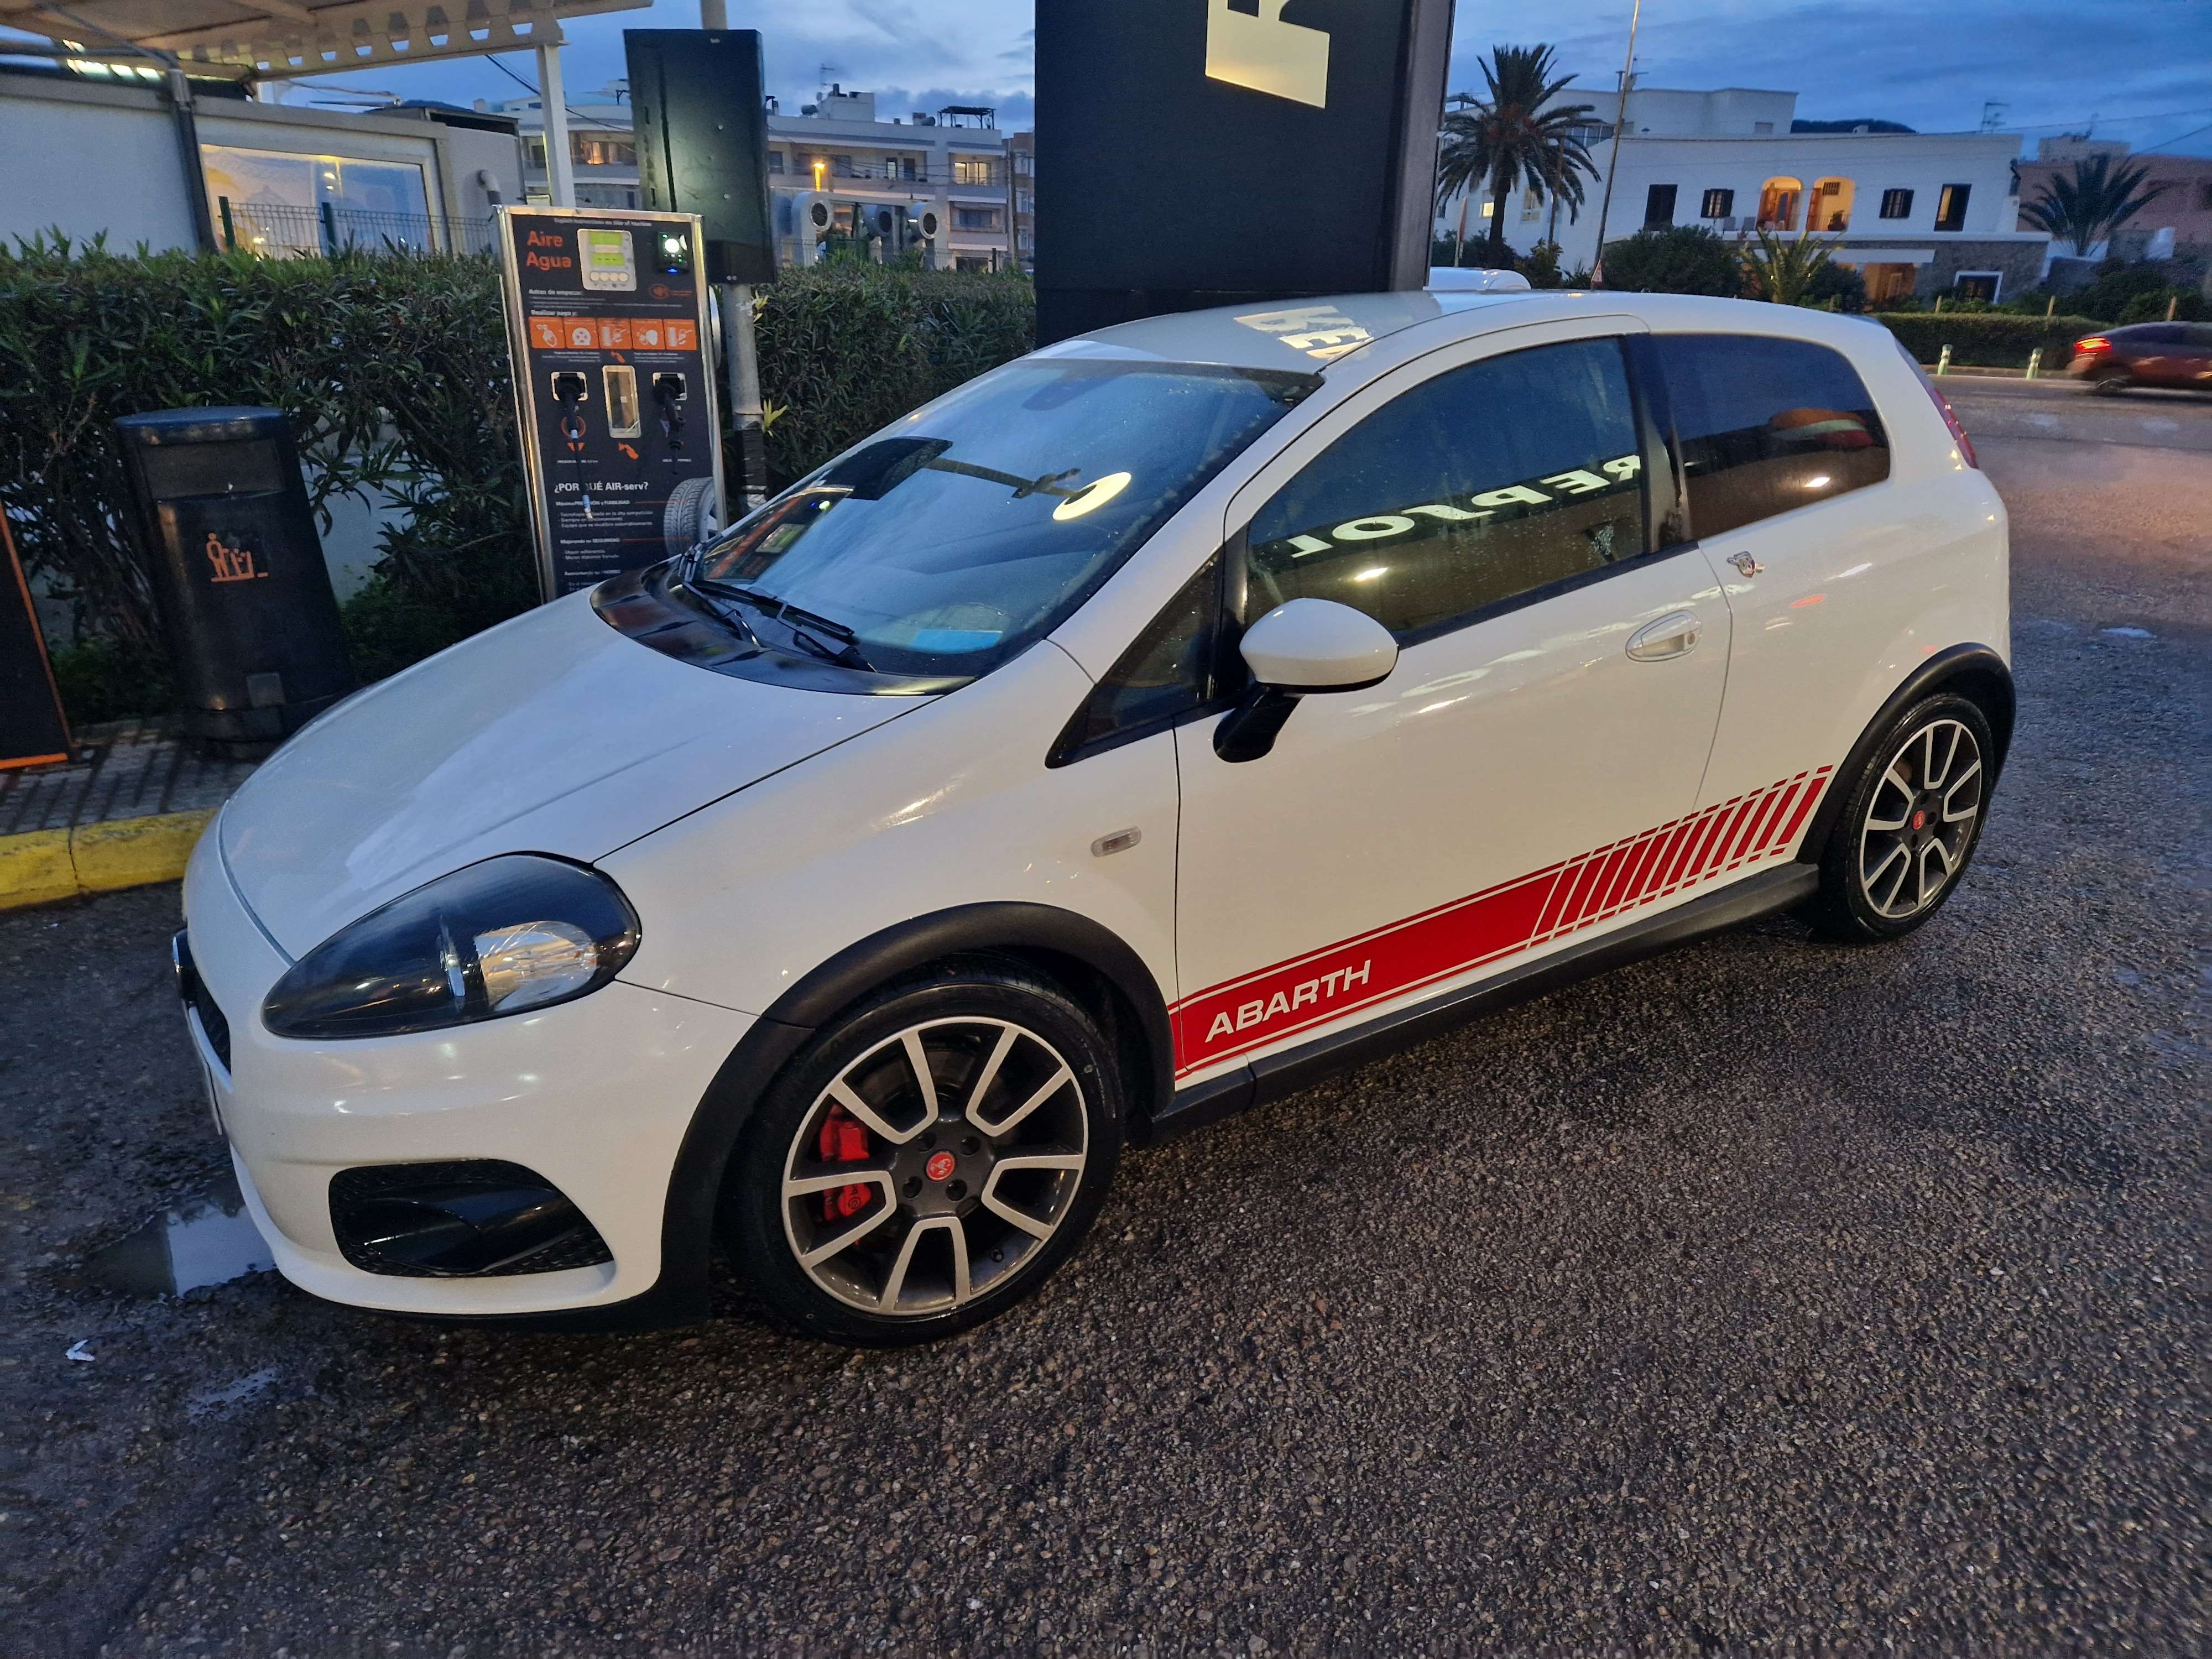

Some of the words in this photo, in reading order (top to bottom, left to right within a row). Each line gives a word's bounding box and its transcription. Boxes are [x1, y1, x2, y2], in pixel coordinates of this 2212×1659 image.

[526, 230, 564, 247] Aire
[526, 251, 572, 271] Agua
[554, 483, 580, 493] ¿POR
[583, 481, 603, 491] UÉ
[606, 481, 649, 491] AIR-serv?
[1204, 959, 1371, 1043] ABARTH
